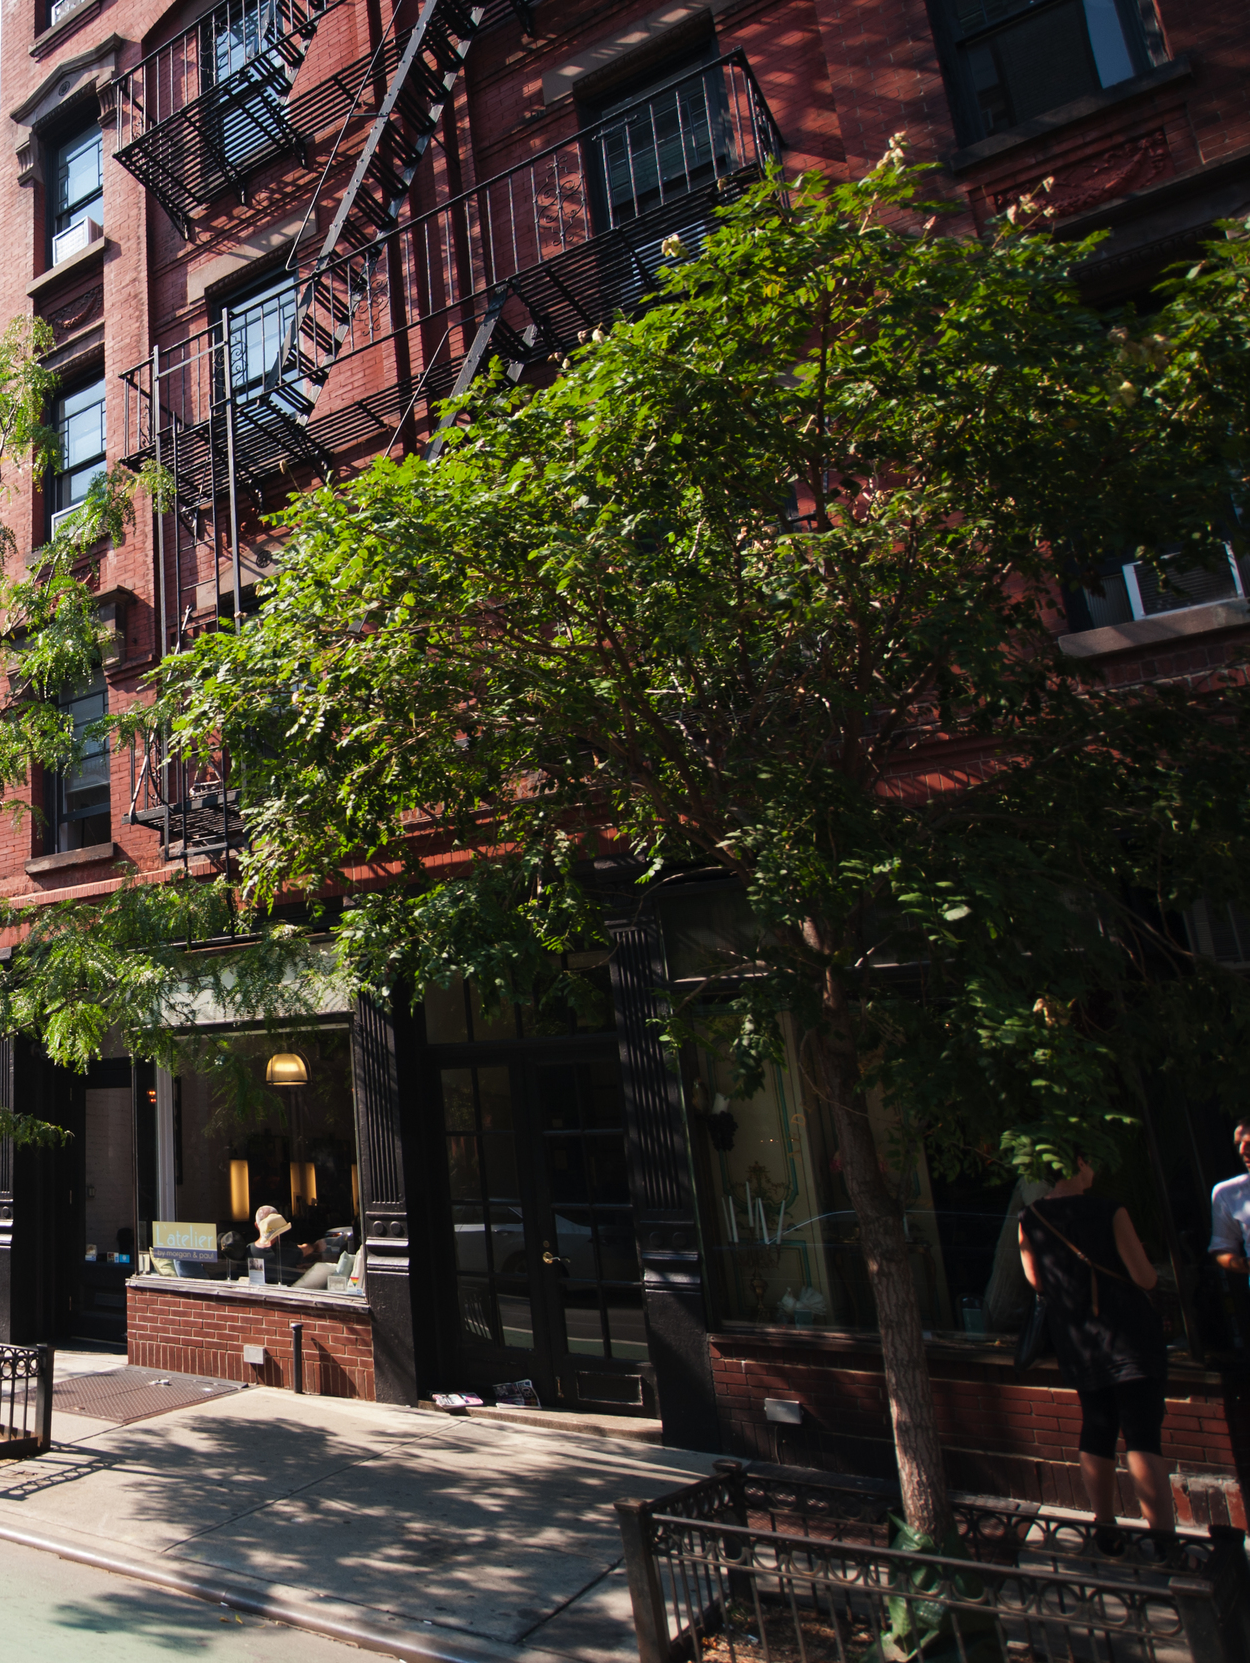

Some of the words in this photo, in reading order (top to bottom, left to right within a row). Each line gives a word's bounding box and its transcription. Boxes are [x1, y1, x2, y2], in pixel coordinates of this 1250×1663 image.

[157, 1249, 166, 1257] by
[166, 1251, 192, 1259] morgan
[192, 1251, 198, 1259] &
[198, 1252, 215, 1260] paul
